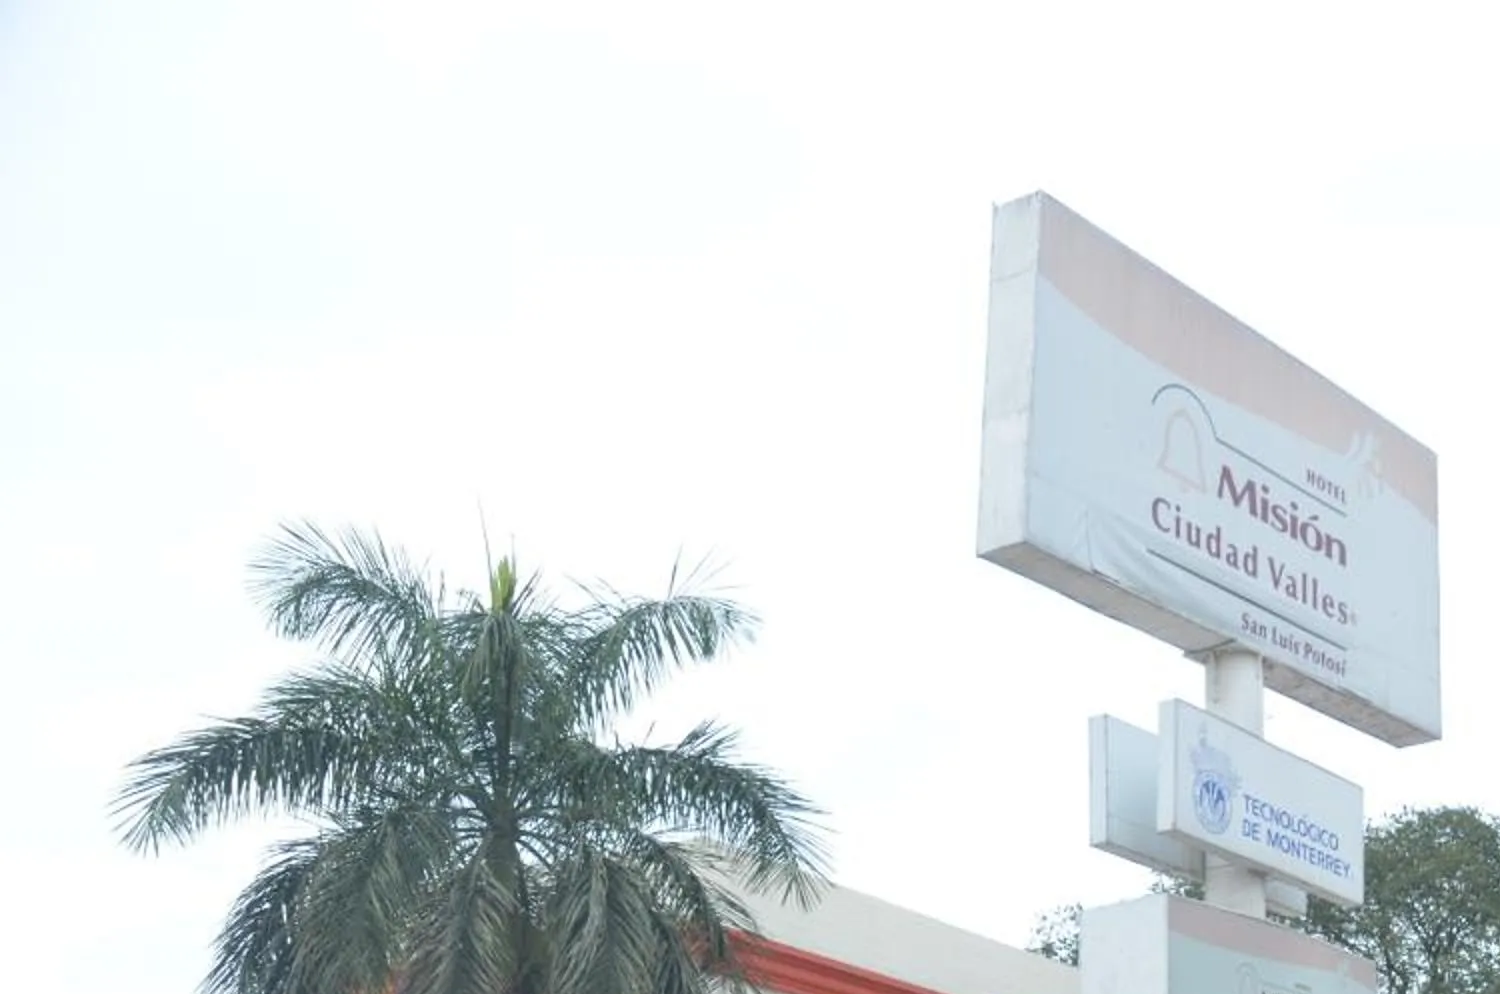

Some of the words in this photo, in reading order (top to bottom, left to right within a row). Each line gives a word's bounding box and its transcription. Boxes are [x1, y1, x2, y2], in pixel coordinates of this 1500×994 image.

[1217, 464, 1347, 567] Misión
[1306, 468, 1347, 505] HOTEL
[1151, 497, 1258, 577] Ciudad
[1267, 555, 1348, 626] Valles
[1241, 613, 1267, 640] San
[1271, 627, 1300, 655] Luis
[1242, 819, 1261, 842] DE
[1266, 828, 1351, 879] MONTERREY
